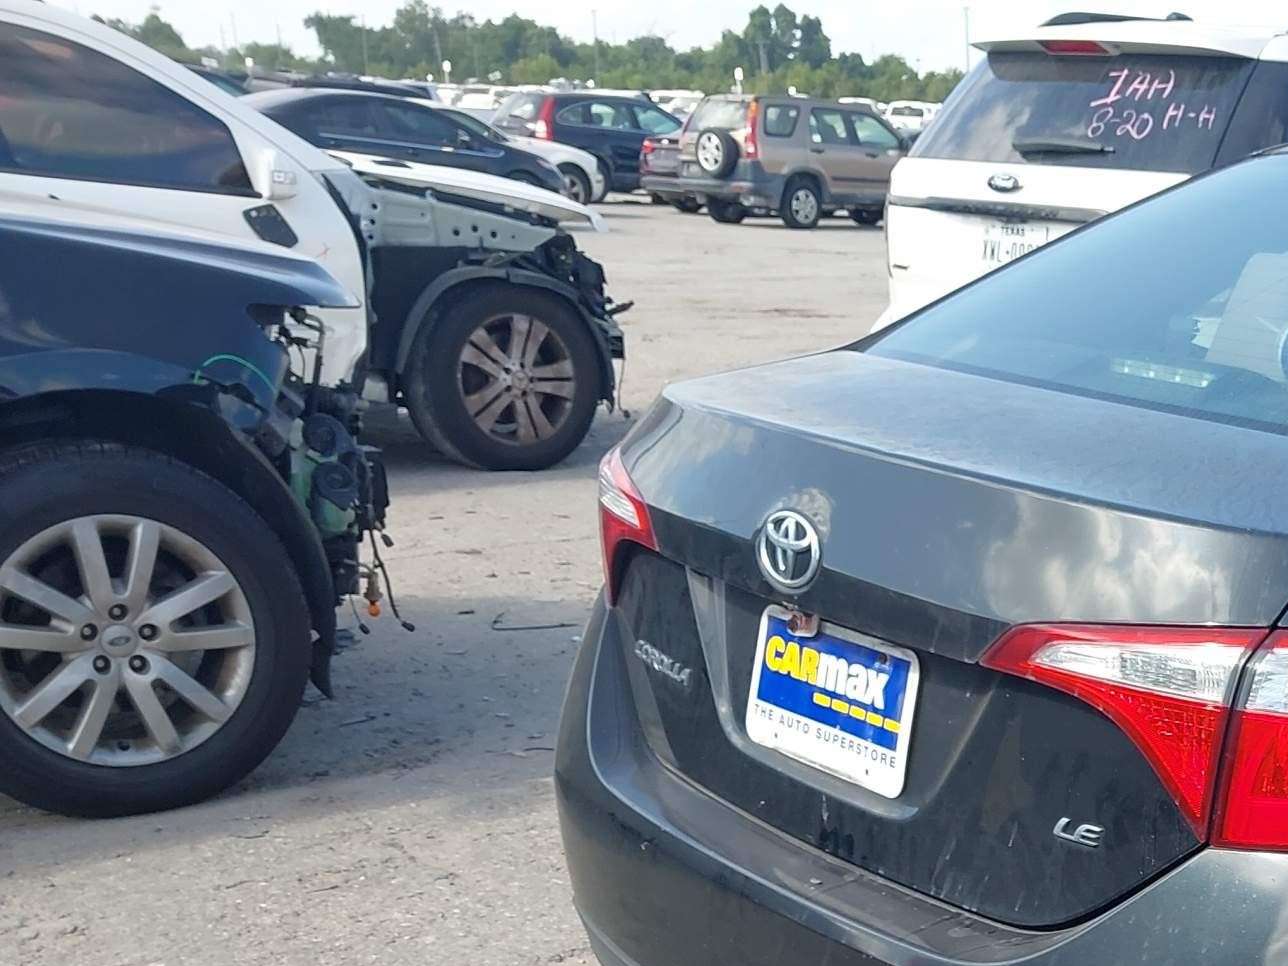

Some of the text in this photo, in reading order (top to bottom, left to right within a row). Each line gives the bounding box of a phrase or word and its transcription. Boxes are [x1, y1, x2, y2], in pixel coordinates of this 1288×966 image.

[1088, 107, 1153, 139] 8-20
[1000, 225, 1025, 237] TEXAS
[754, 704, 897, 769] THE AUTO SUPERSTORE
[1053, 816, 1104, 847] LE
